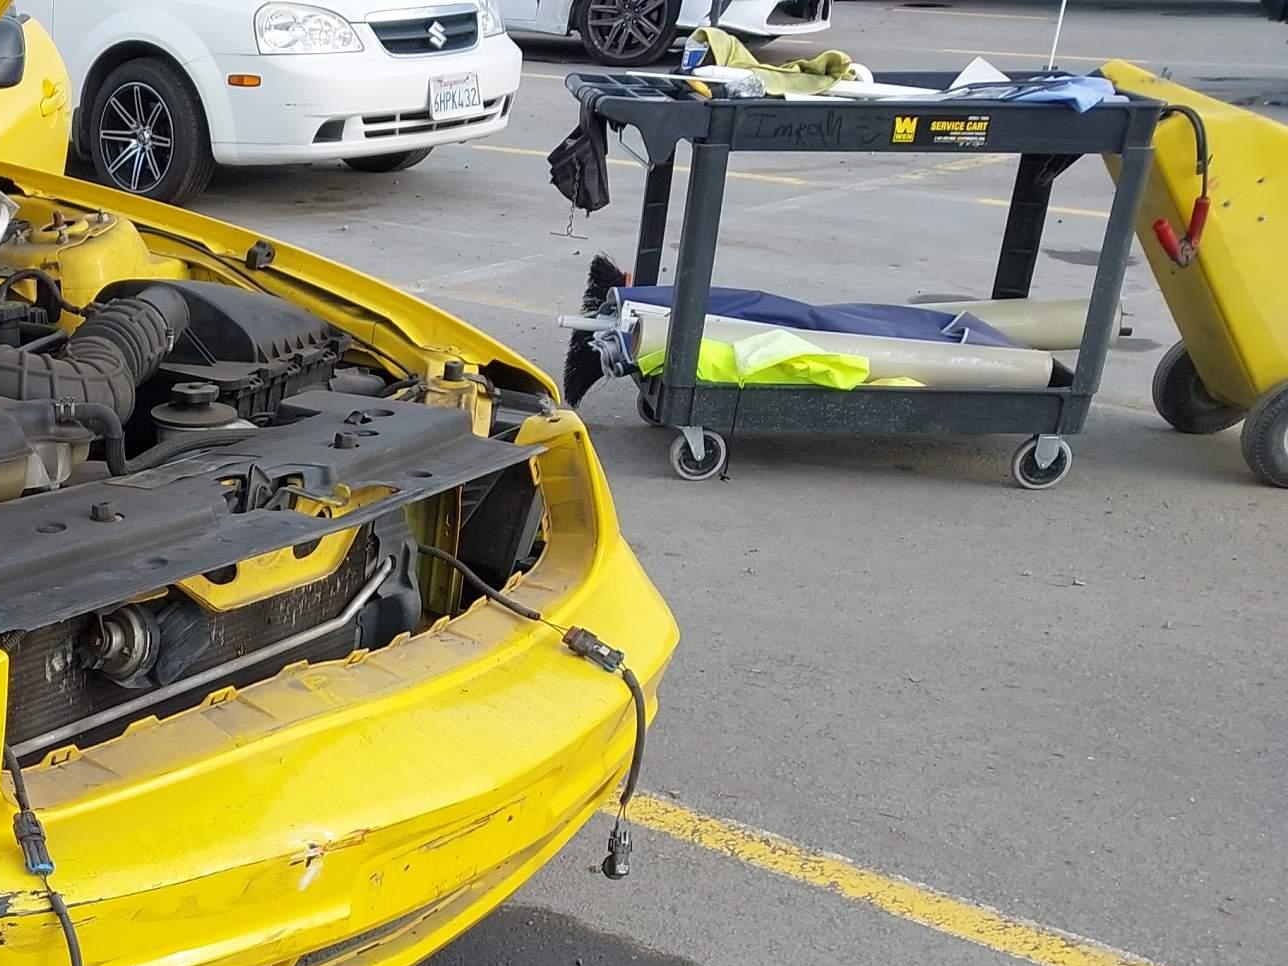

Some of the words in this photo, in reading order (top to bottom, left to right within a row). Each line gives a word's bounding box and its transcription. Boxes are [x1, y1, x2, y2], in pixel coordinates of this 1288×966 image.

[434, 88, 478, 112] 6HPK432
[931, 121, 965, 131] SERVICE
[966, 121, 988, 131] CART
